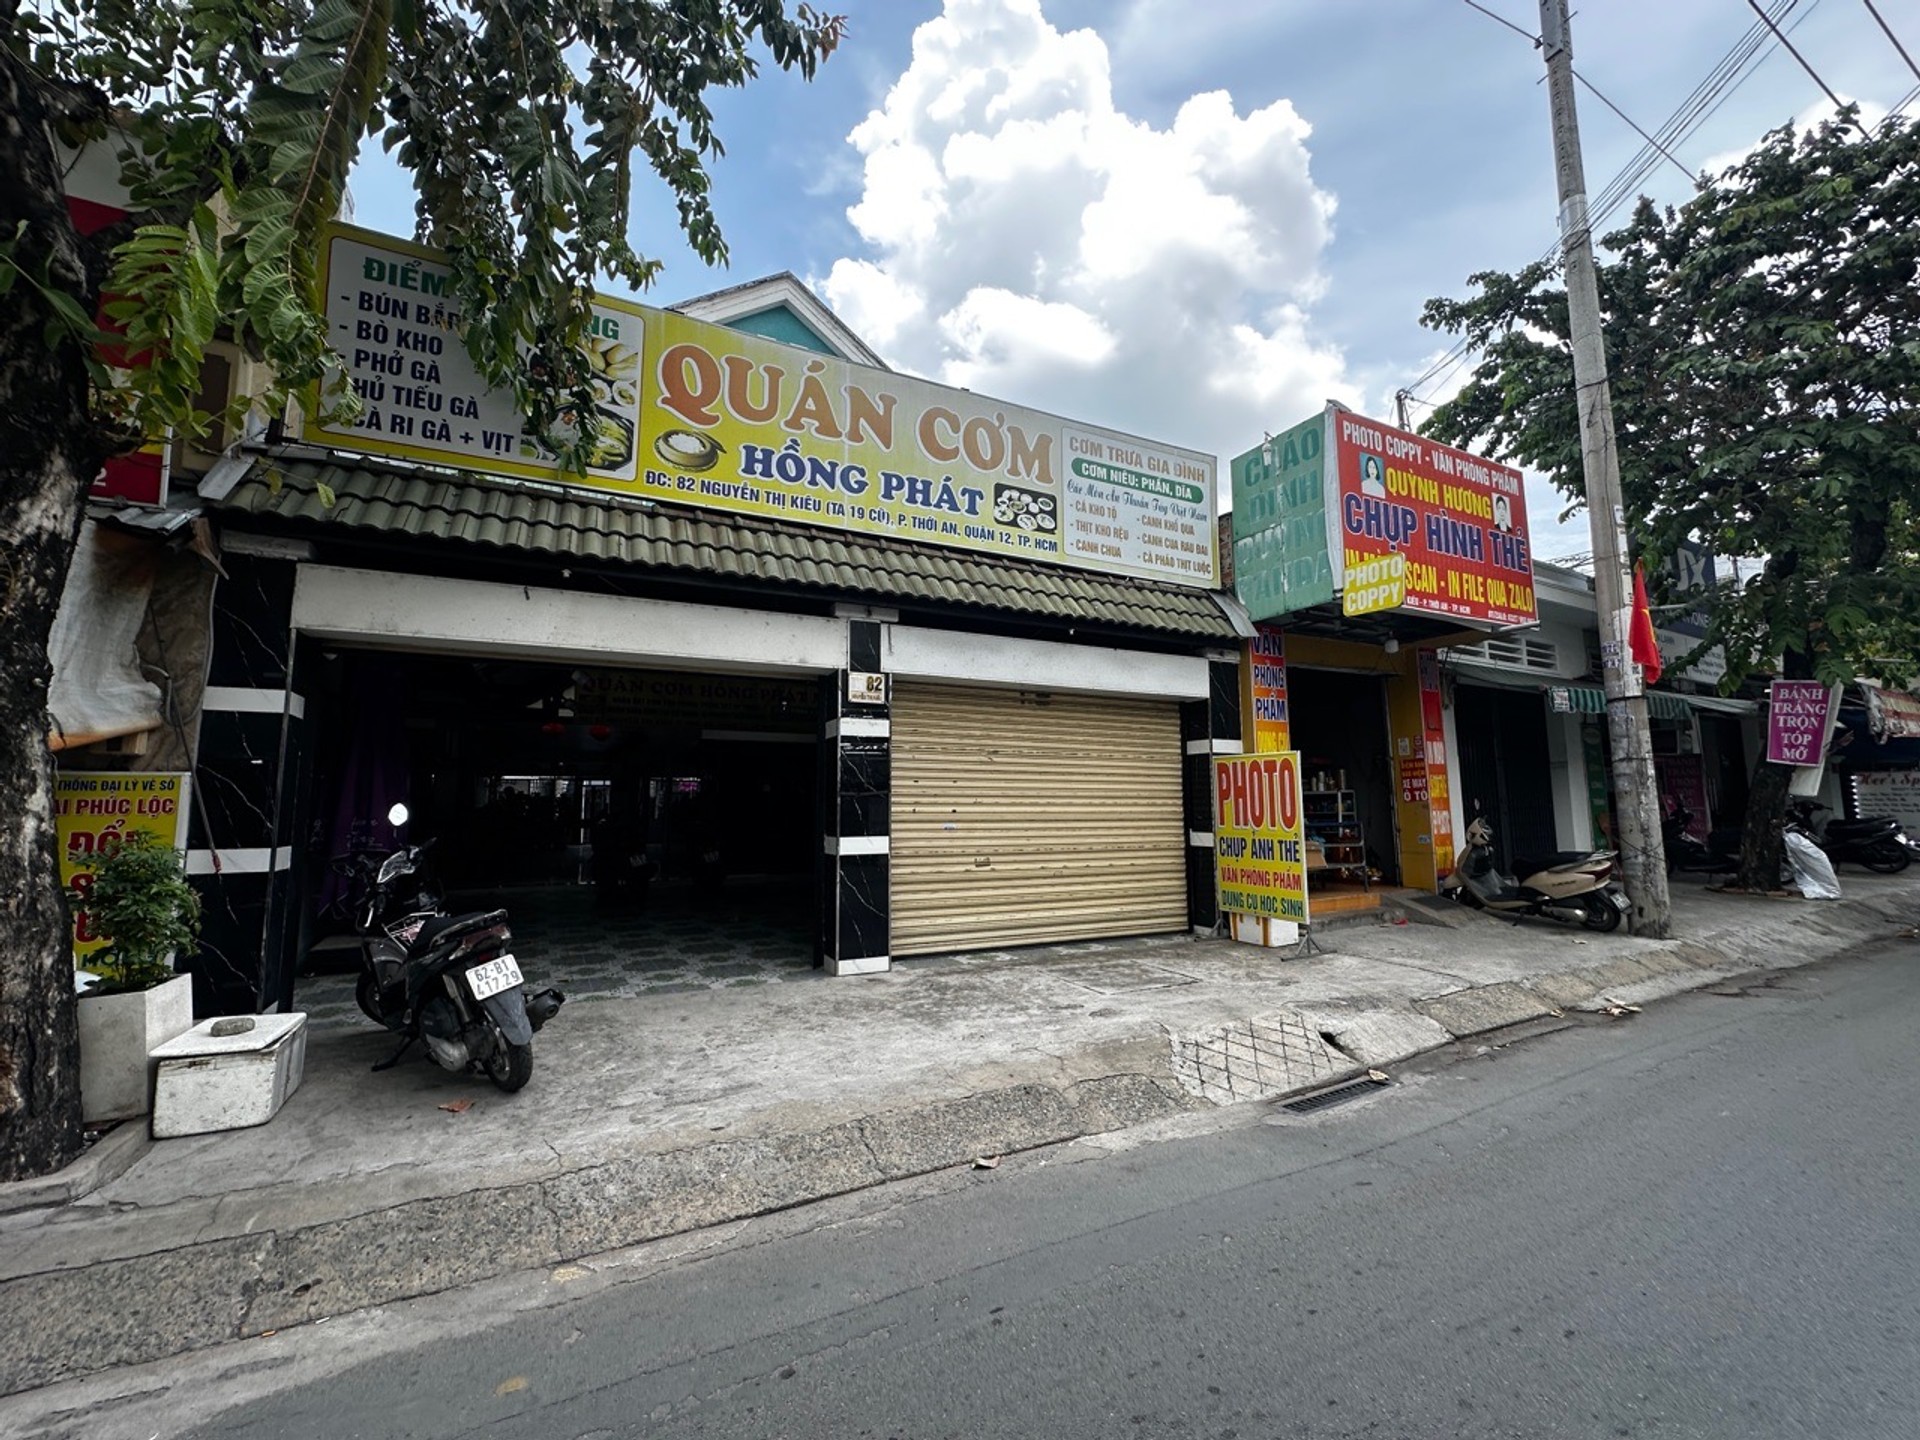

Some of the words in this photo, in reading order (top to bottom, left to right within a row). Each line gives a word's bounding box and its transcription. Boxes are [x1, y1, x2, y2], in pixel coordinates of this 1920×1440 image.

[358, 291, 408, 320] BÚN
[356, 320, 388, 344] BÒ
[396, 328, 443, 356] KHO
[354, 349, 404, 376] PHỞ
[411, 361, 441, 384] GÀ
[392, 384, 442, 412] TIẾU
[450, 395, 479, 420] GÀ
[659, 345, 896, 451] QUÁN
[917, 406, 1054, 484] CƠM
[390, 414, 414, 436] RI
[421, 418, 451, 443] GÀ
[482, 430, 515, 455] VỊT
[1070, 436, 1103, 458] CƠM
[1106, 445, 1143, 468] TRƯA
[1148, 455, 1170, 475] GIA
[1342, 420, 1383, 452] PHOTO
[1385, 435, 1422, 464] COPPY
[1431, 449, 1454, 476] VĂN
[1456, 457, 1490, 486] PHÒNG
[740, 437, 868, 495] HỒNG
[881, 475, 984, 516] PHÁT
[1081, 463, 1107, 480] CƠM
[1385, 468, 1440, 505] QUỲNH
[1443, 484, 1492, 519] HƯƠNG
[645, 470, 671, 487] ĐC:
[676, 476, 696, 492] 82
[764, 490, 786, 509] THỊ
[826, 501, 845, 517] (TA
[850, 505, 865, 520] 19
[898, 513, 908, 527] P.
[964, 525, 994, 542] QUẬN
[1017, 534, 1032, 548] TP.
[1035, 538, 1058, 552] HCM
[1344, 492, 1418, 550] CHỤP
[1426, 509, 1484, 563] HÌNH
[1488, 527, 1529, 576] THẺ
[1344, 556, 1402, 590] PHOTO
[1405, 562, 1438, 594] SCAN
[1448, 569, 1459, 598] IN
[1462, 573, 1485, 603] FILE
[1487, 578, 1508, 609] QUA
[1509, 582, 1534, 613] ZALO
[1346, 582, 1401, 612] COPPY
[1252, 629, 1283, 656] VĂN
[866, 675, 883, 692] 82
[1254, 660, 1284, 688] PHÒNG
[1773, 700, 1827, 715] TRÁNG
[1779, 685, 1823, 700] BÁNH
[1777, 715, 1820, 731] TRỘN
[1781, 731, 1812, 745] TÓP
[101, 780, 121, 793] ĐẠI
[142, 778, 156, 791] VÉ
[1216, 758, 1297, 831] PHOTO
[75, 795, 131, 815] PHÚC
[137, 795, 175, 818] LỘC
[1219, 837, 1247, 862] CHỤP
[1251, 831, 1274, 861] ẢNH
[1277, 832, 1300, 862] THẺ
[1221, 864, 1238, 884] VĂN
[1240, 865, 1270, 888] PHÒNG
[1222, 890, 1243, 910] DỤNG
[1246, 893, 1258, 914] CỤ
[1260, 895, 1278, 916] HỌC
[1281, 898, 1303, 918] SINH
[474, 959, 509, 981] 62-B1
